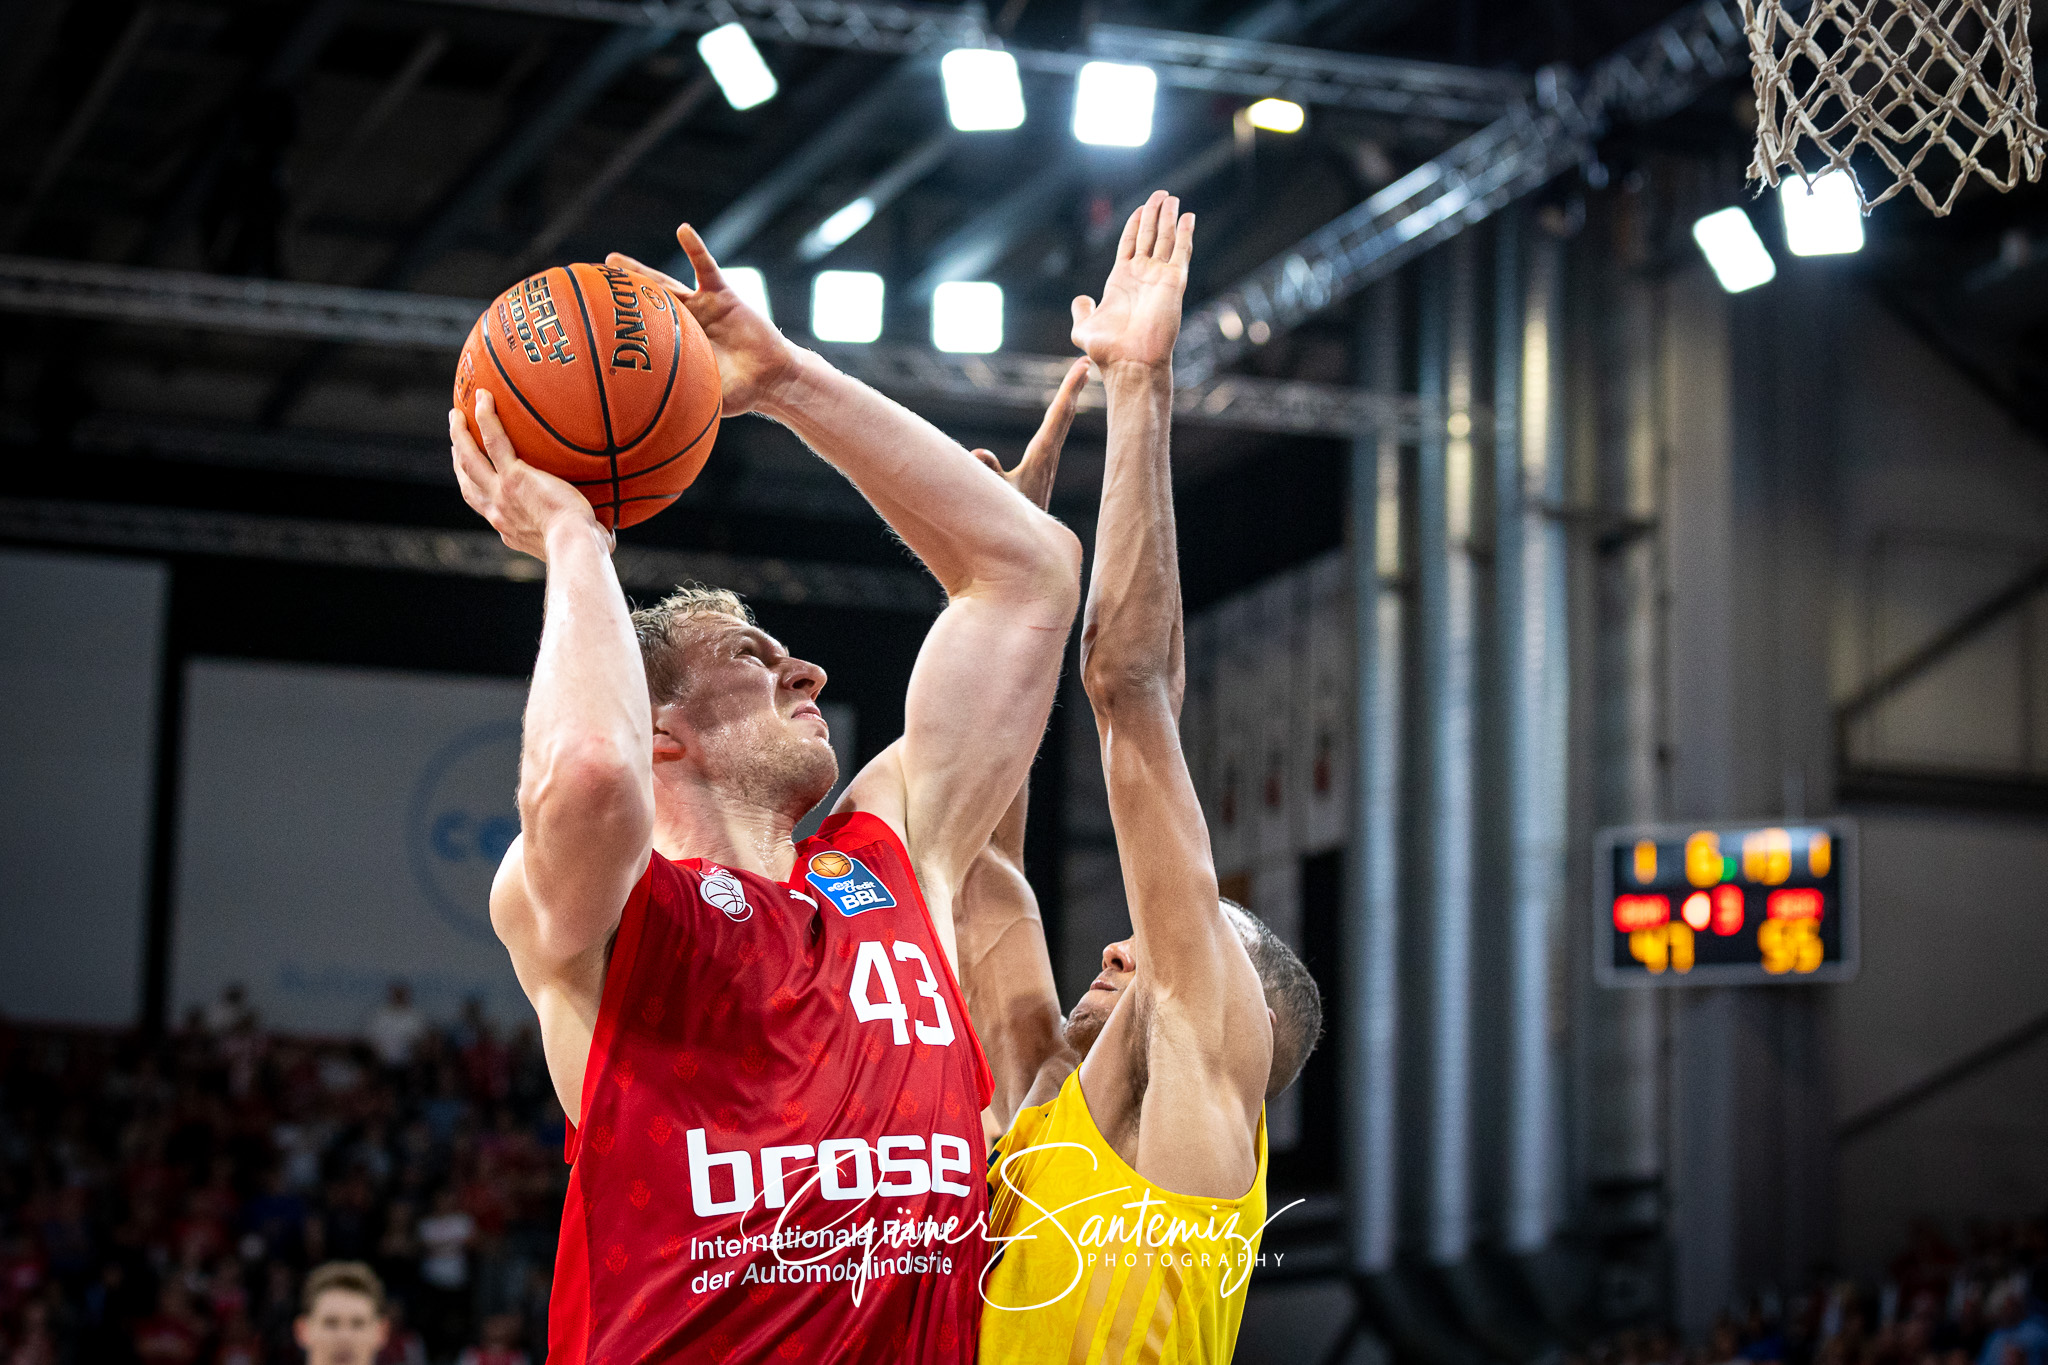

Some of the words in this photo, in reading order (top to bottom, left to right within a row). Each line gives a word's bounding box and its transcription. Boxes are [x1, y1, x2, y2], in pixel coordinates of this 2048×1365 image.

[596, 264, 653, 372] ALDING
[840, 889, 886, 910] BBL
[849, 940, 955, 1046] 43
[686, 1127, 971, 1217] brose
[690, 1222, 877, 1260] Internationaler
[691, 1269, 735, 1294] der
